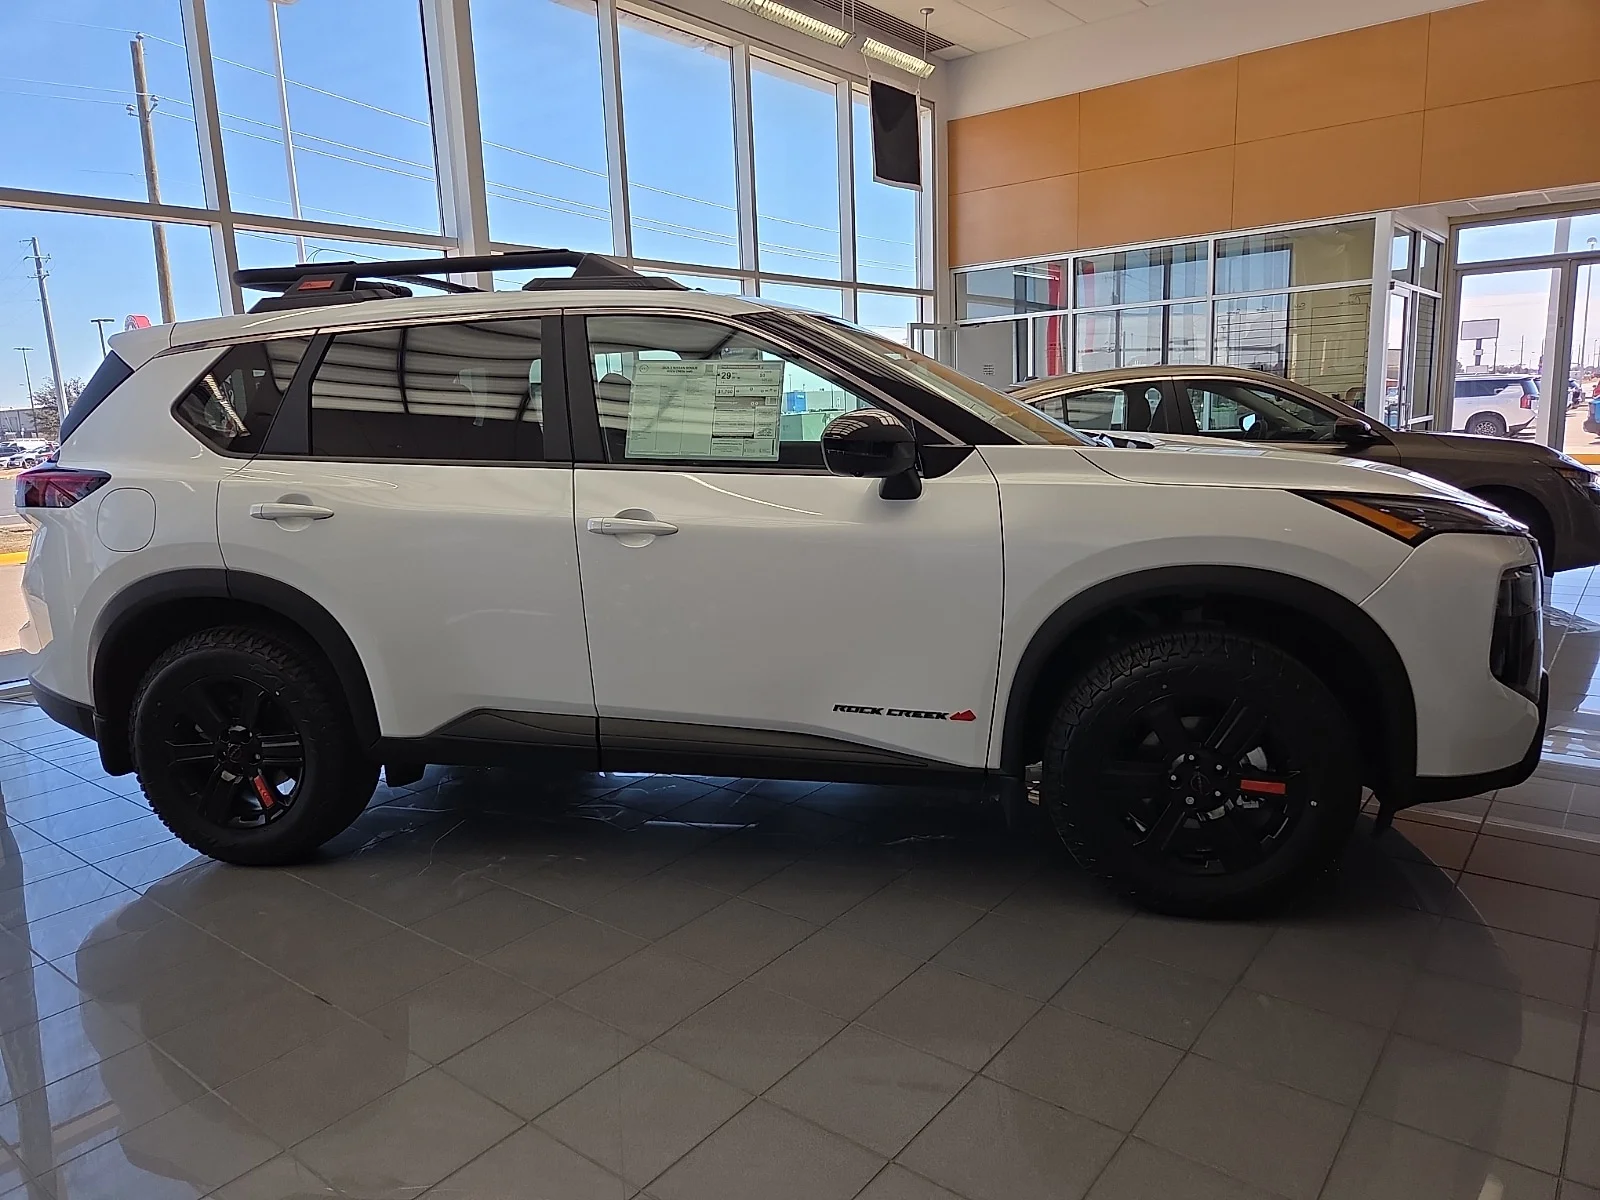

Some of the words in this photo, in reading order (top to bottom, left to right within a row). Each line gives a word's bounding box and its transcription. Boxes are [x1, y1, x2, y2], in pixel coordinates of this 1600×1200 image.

[721, 371, 732, 379] 29
[832, 704, 884, 716] ROCK
[885, 708, 950, 720] CREEK
